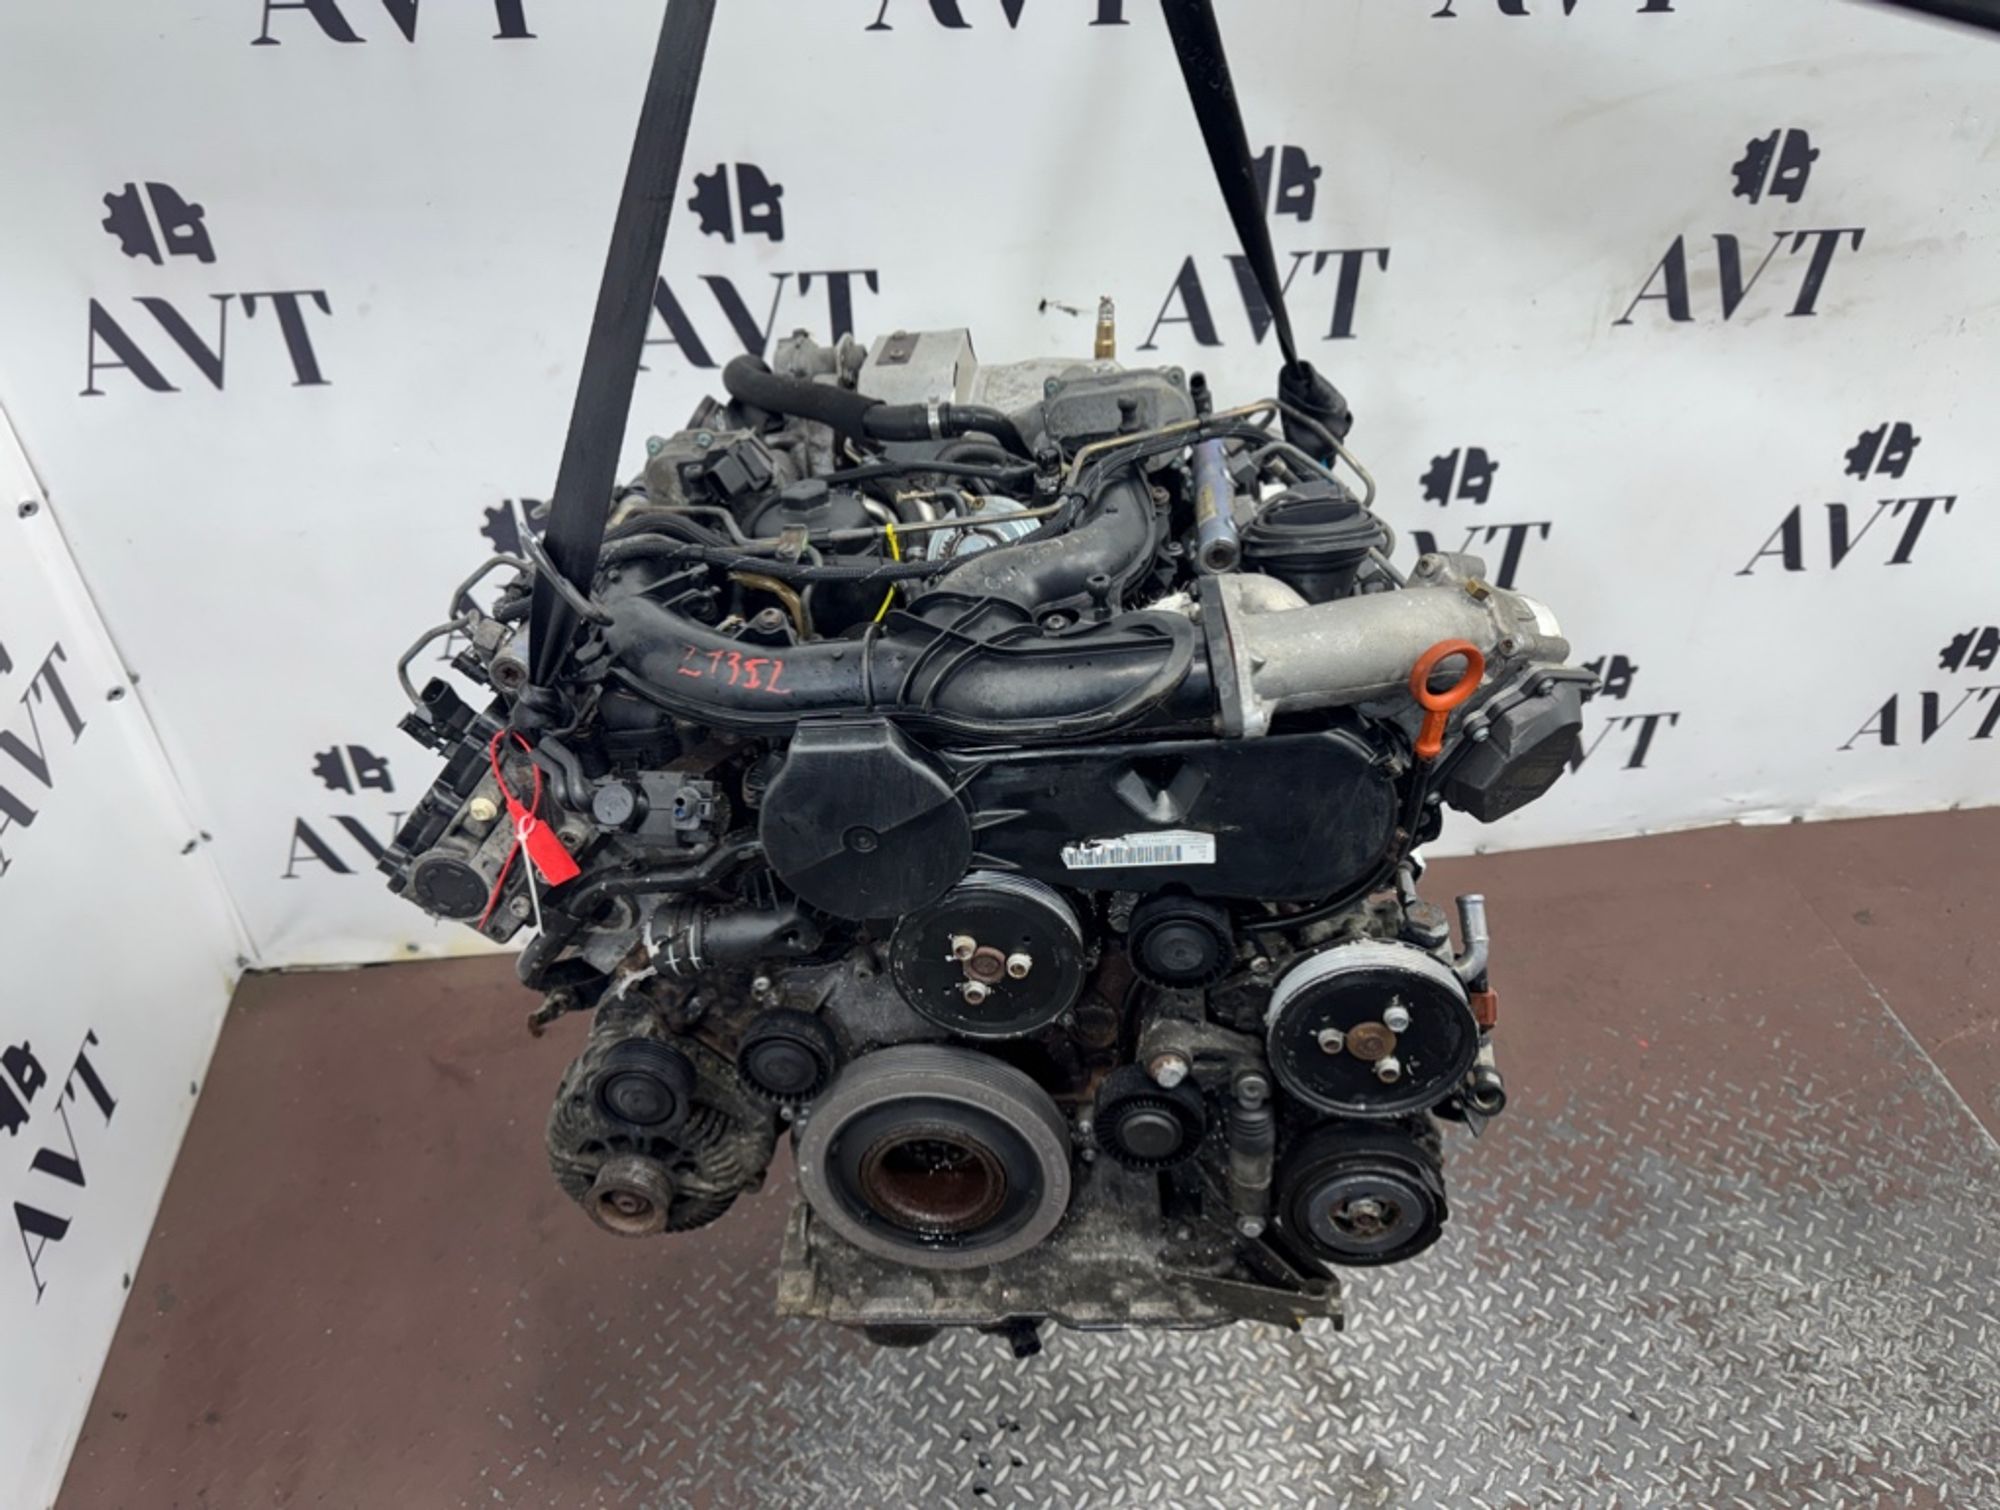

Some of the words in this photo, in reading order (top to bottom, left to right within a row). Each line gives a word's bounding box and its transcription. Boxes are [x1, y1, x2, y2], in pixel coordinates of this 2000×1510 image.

[638, 269, 879, 371] AVT
[1136, 247, 1391, 350] AVT
[1612, 228, 1866, 325] AVT
[79, 290, 332, 395] AVT
[1735, 496, 1957, 576] AVT
[281, 810, 407, 879] AV
[13, 1028, 118, 1304] AVT
